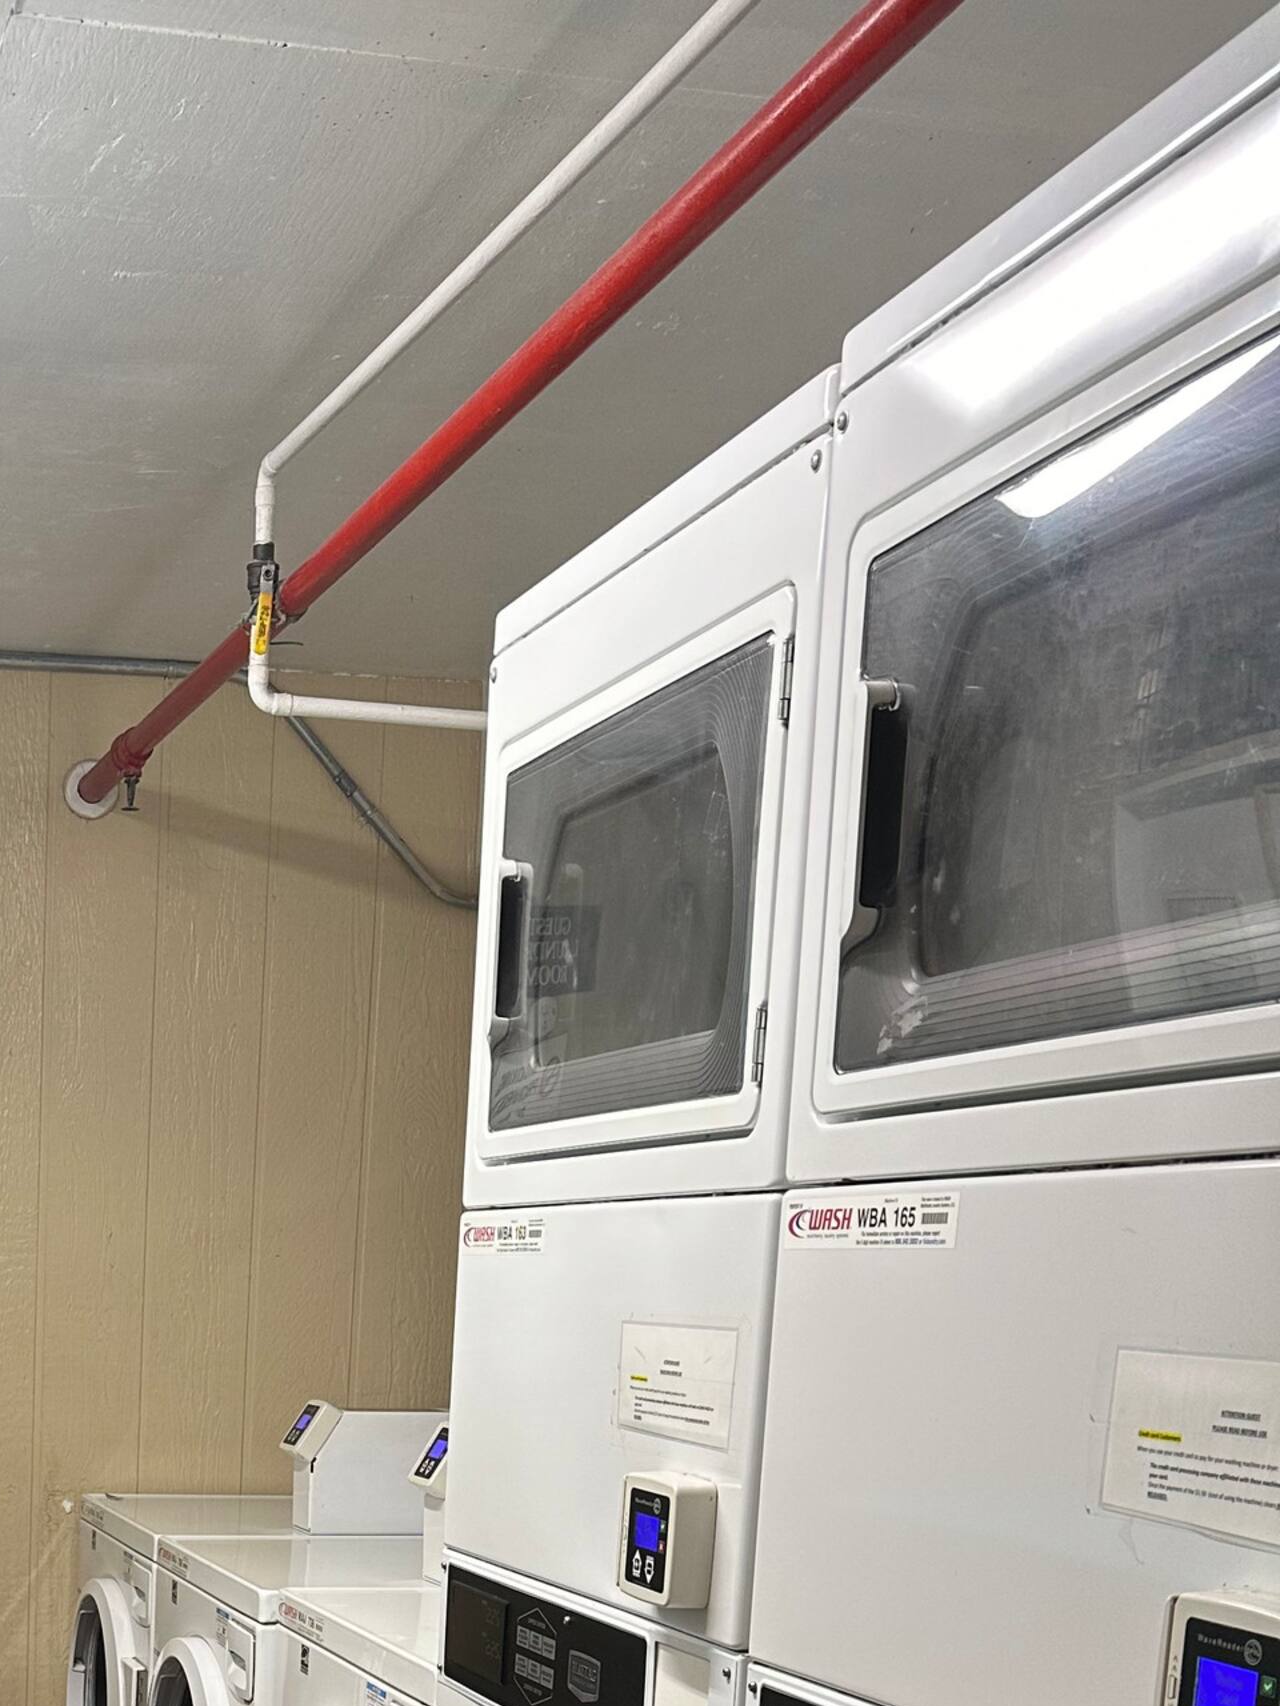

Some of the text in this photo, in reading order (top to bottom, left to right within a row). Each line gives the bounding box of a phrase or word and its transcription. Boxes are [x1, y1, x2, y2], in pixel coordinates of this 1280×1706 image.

[808, 1206, 917, 1231] WASH WBA 165
